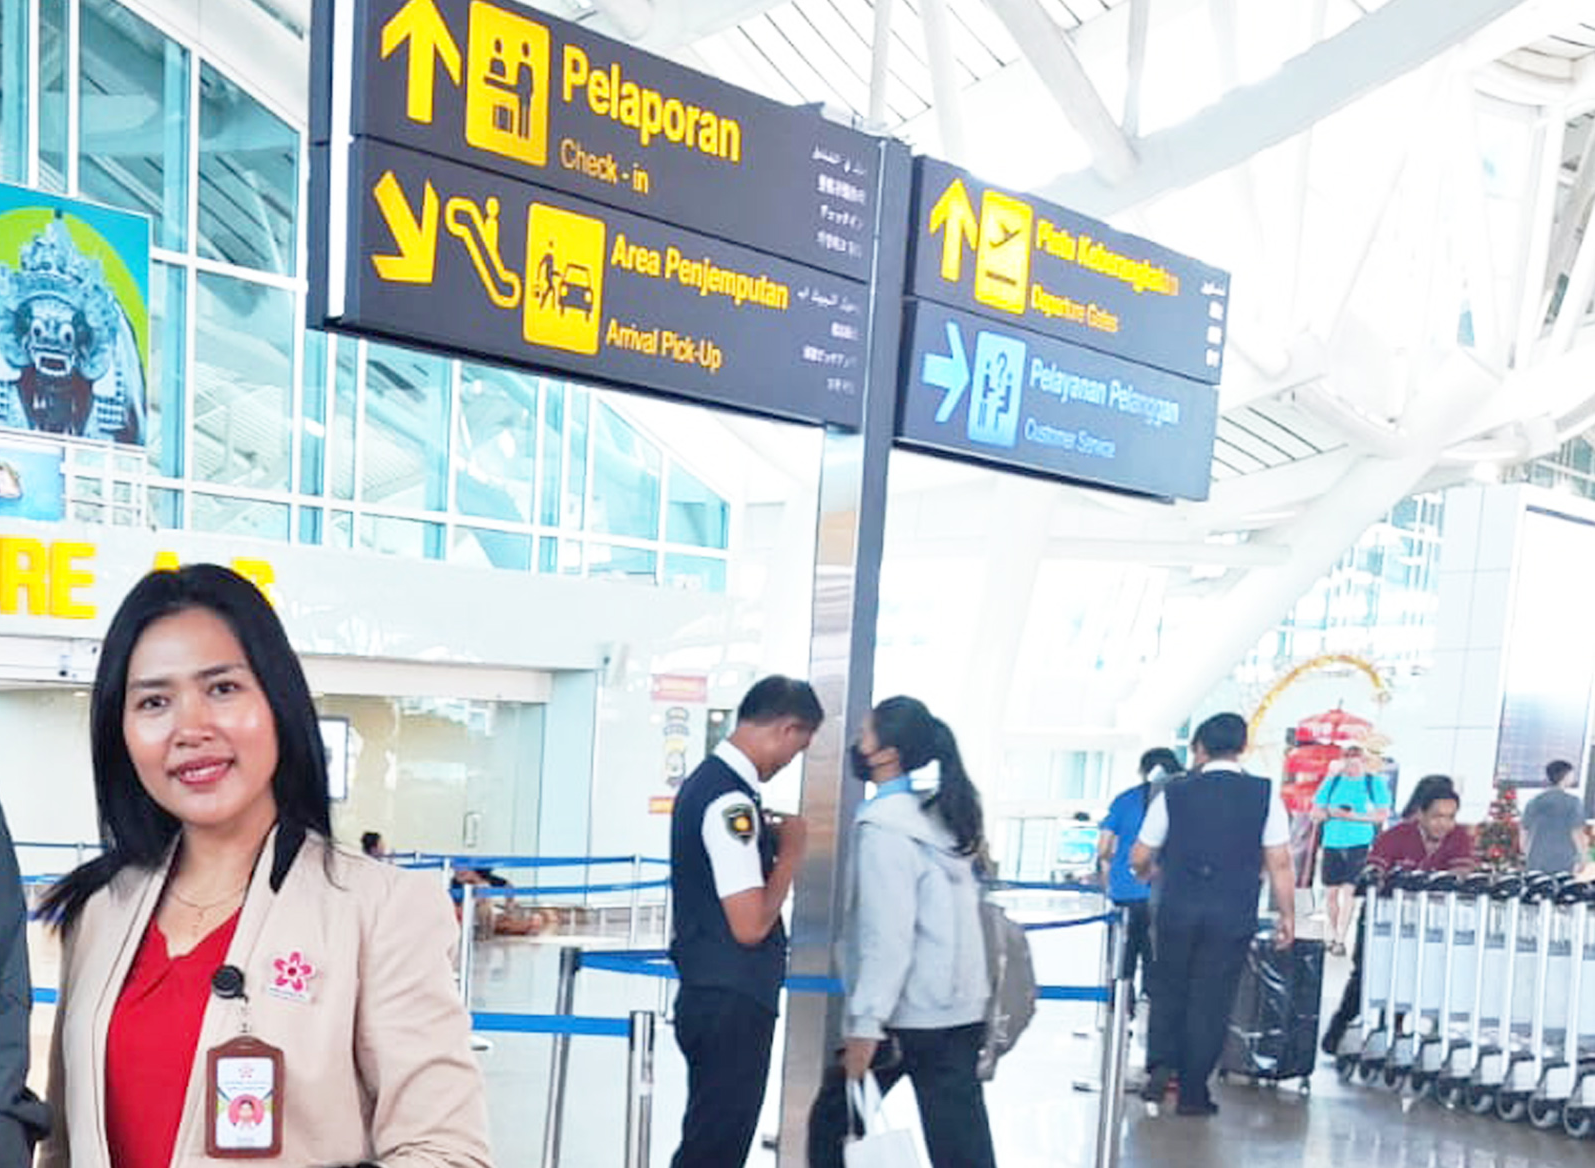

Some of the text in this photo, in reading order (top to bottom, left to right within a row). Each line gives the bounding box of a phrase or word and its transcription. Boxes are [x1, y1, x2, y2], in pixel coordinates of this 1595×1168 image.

[563, 44, 741, 162] Pelaporan
[561, 138, 617, 184] Check
[632, 162, 649, 193] in
[611, 233, 661, 276] Area
[665, 246, 789, 309] Penjemputan
[607, 317, 722, 374] Arrival Pick-Up
[1030, 358, 1106, 404] Pelayanan
